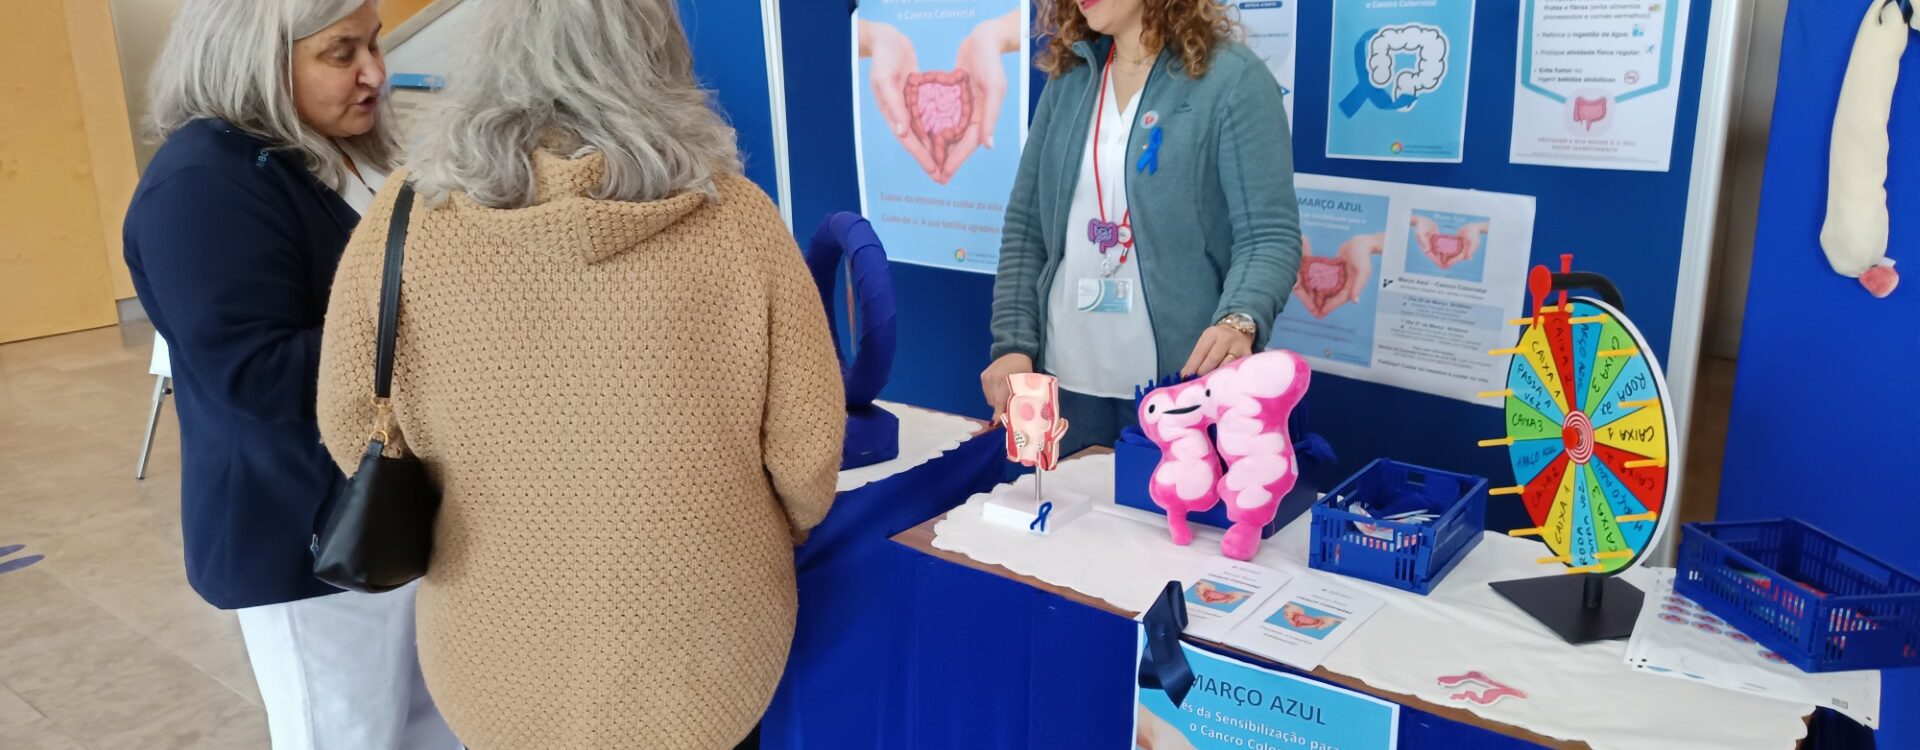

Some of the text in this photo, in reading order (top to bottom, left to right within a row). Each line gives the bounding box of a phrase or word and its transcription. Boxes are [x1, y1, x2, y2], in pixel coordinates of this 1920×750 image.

[1337, 200, 1363, 212] AZUL
[1531, 340, 1554, 383] CAIXA
[1600, 335, 1620, 381] CIXA
[1517, 363, 1543, 397] PASSA
[1616, 372, 1646, 403] RODA
[1524, 393, 1541, 410] VEZ
[1511, 412, 1544, 433] CAIXA 3
[1607, 426, 1655, 442] CAIXA 1
[1554, 500, 1568, 545] CAIXA
[1597, 502, 1618, 552] CAIXA
[1577, 526, 1588, 566] RODA
[1196, 706, 1211, 719] da
[1215, 711, 1306, 746] Sensibilização
[1269, 695, 1326, 726] AZUL
[1189, 723, 1197, 732] o
[1200, 725, 1244, 746] Cancro
